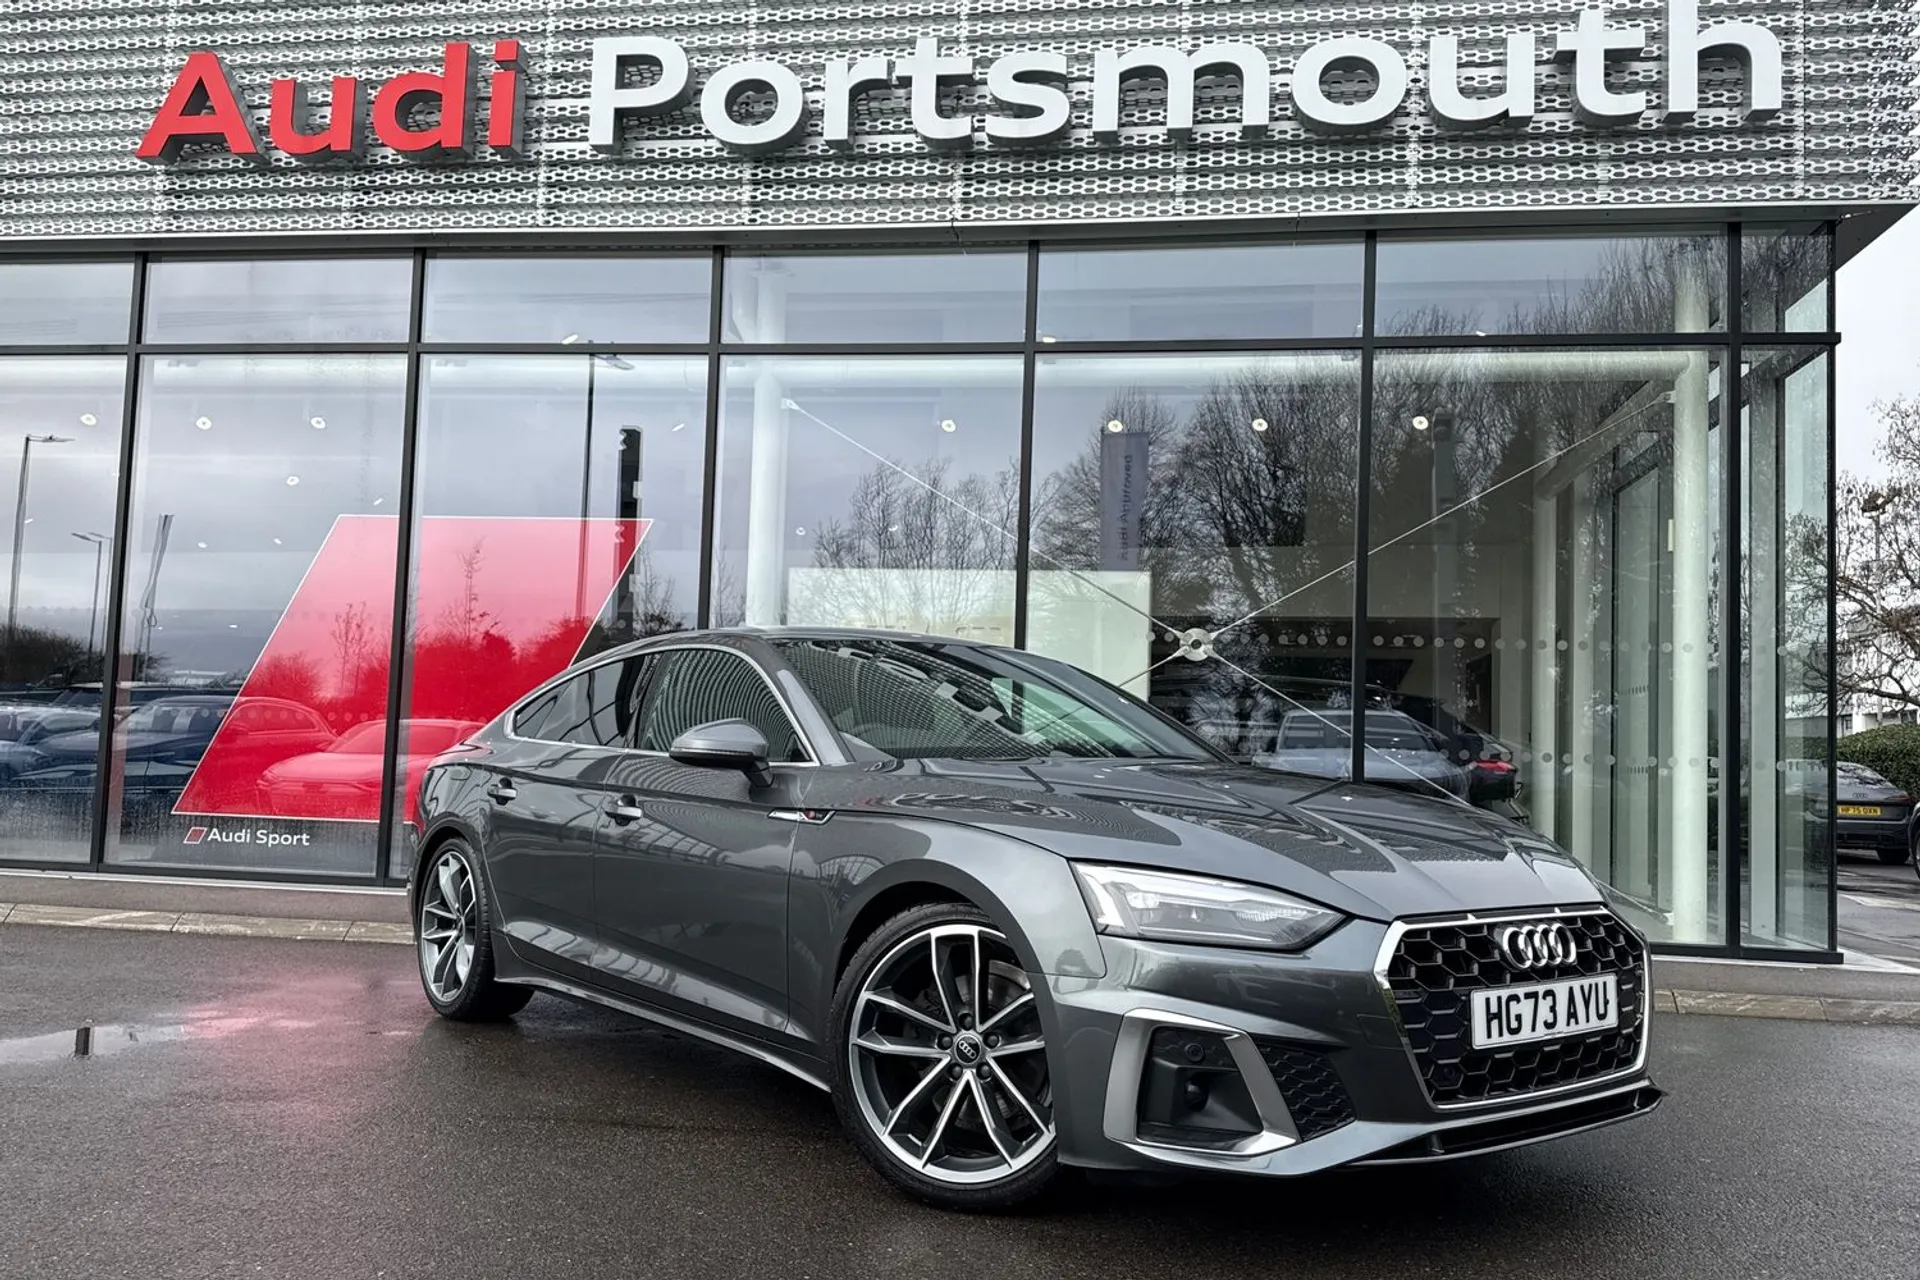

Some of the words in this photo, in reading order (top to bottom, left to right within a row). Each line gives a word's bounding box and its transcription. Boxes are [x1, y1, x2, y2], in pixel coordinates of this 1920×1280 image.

[135, 39, 520, 159] Audi
[588, 0, 1783, 148] Portsmouth
[1119, 455, 1133, 523] Approved
[207, 828, 250, 843] Audi
[256, 830, 310, 847] Sport
[1485, 989, 1558, 1039] HG73
[1566, 981, 1610, 1027] AYU
